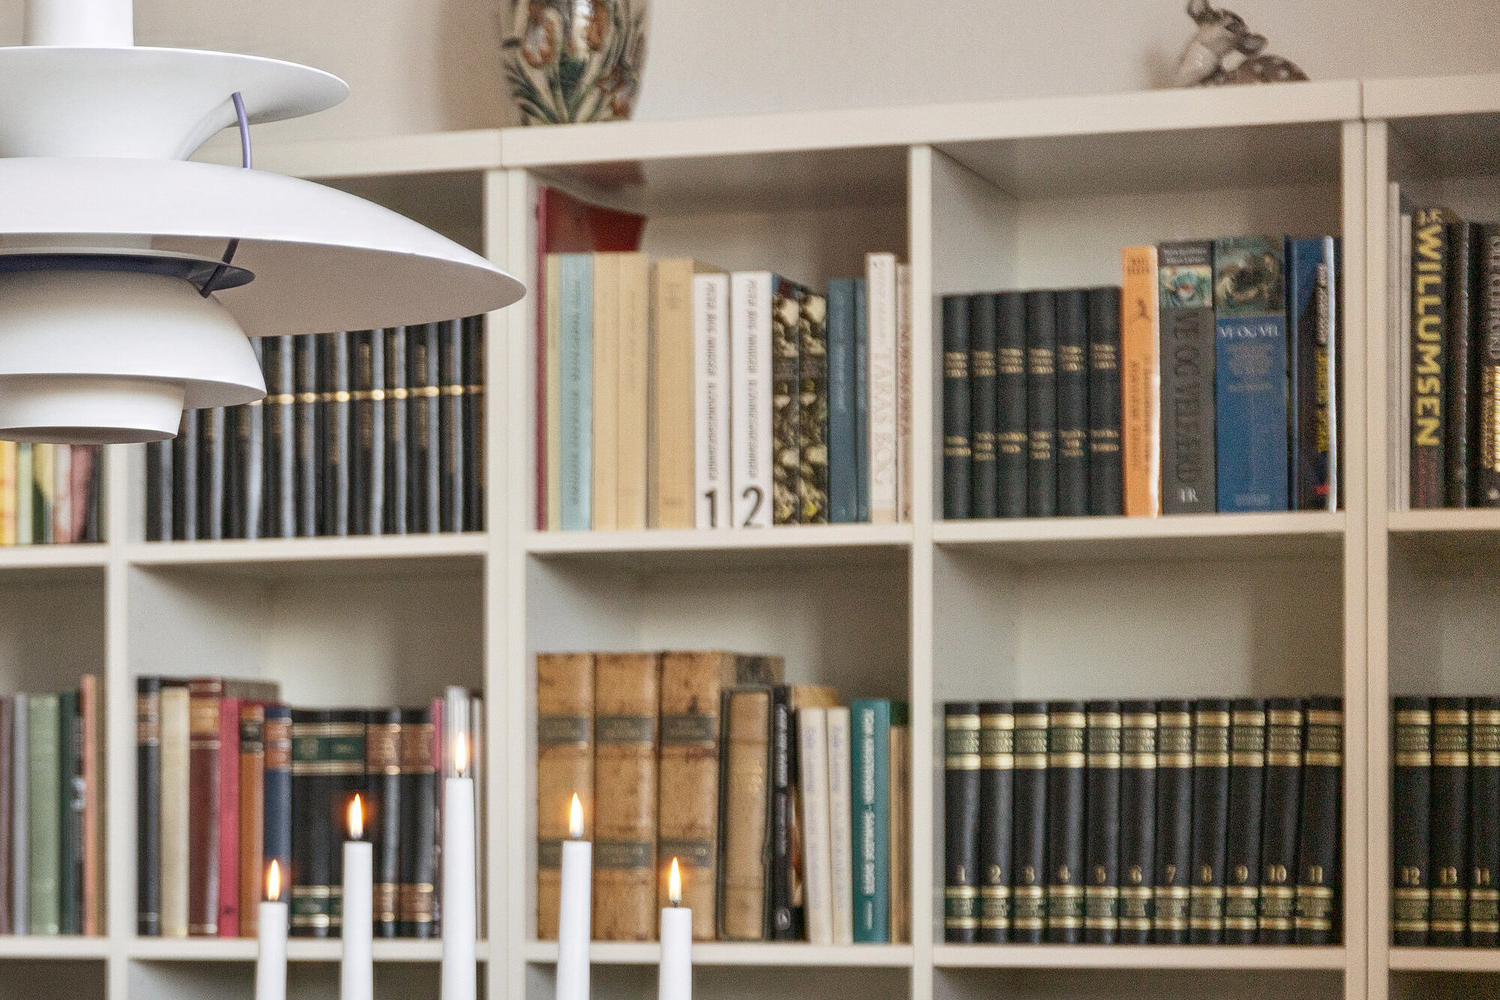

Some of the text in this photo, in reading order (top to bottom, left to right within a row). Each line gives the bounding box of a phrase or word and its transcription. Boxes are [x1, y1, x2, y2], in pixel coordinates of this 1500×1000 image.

[1415, 224, 1442, 447] WILLUMSEN
[704, 489, 719, 527] 1
[742, 486, 765, 528] 2
[989, 864, 1002, 884] 2
[1165, 865, 1177, 883] 7
[1267, 865, 1287, 883] 10
[1402, 866, 1420, 885] 12
